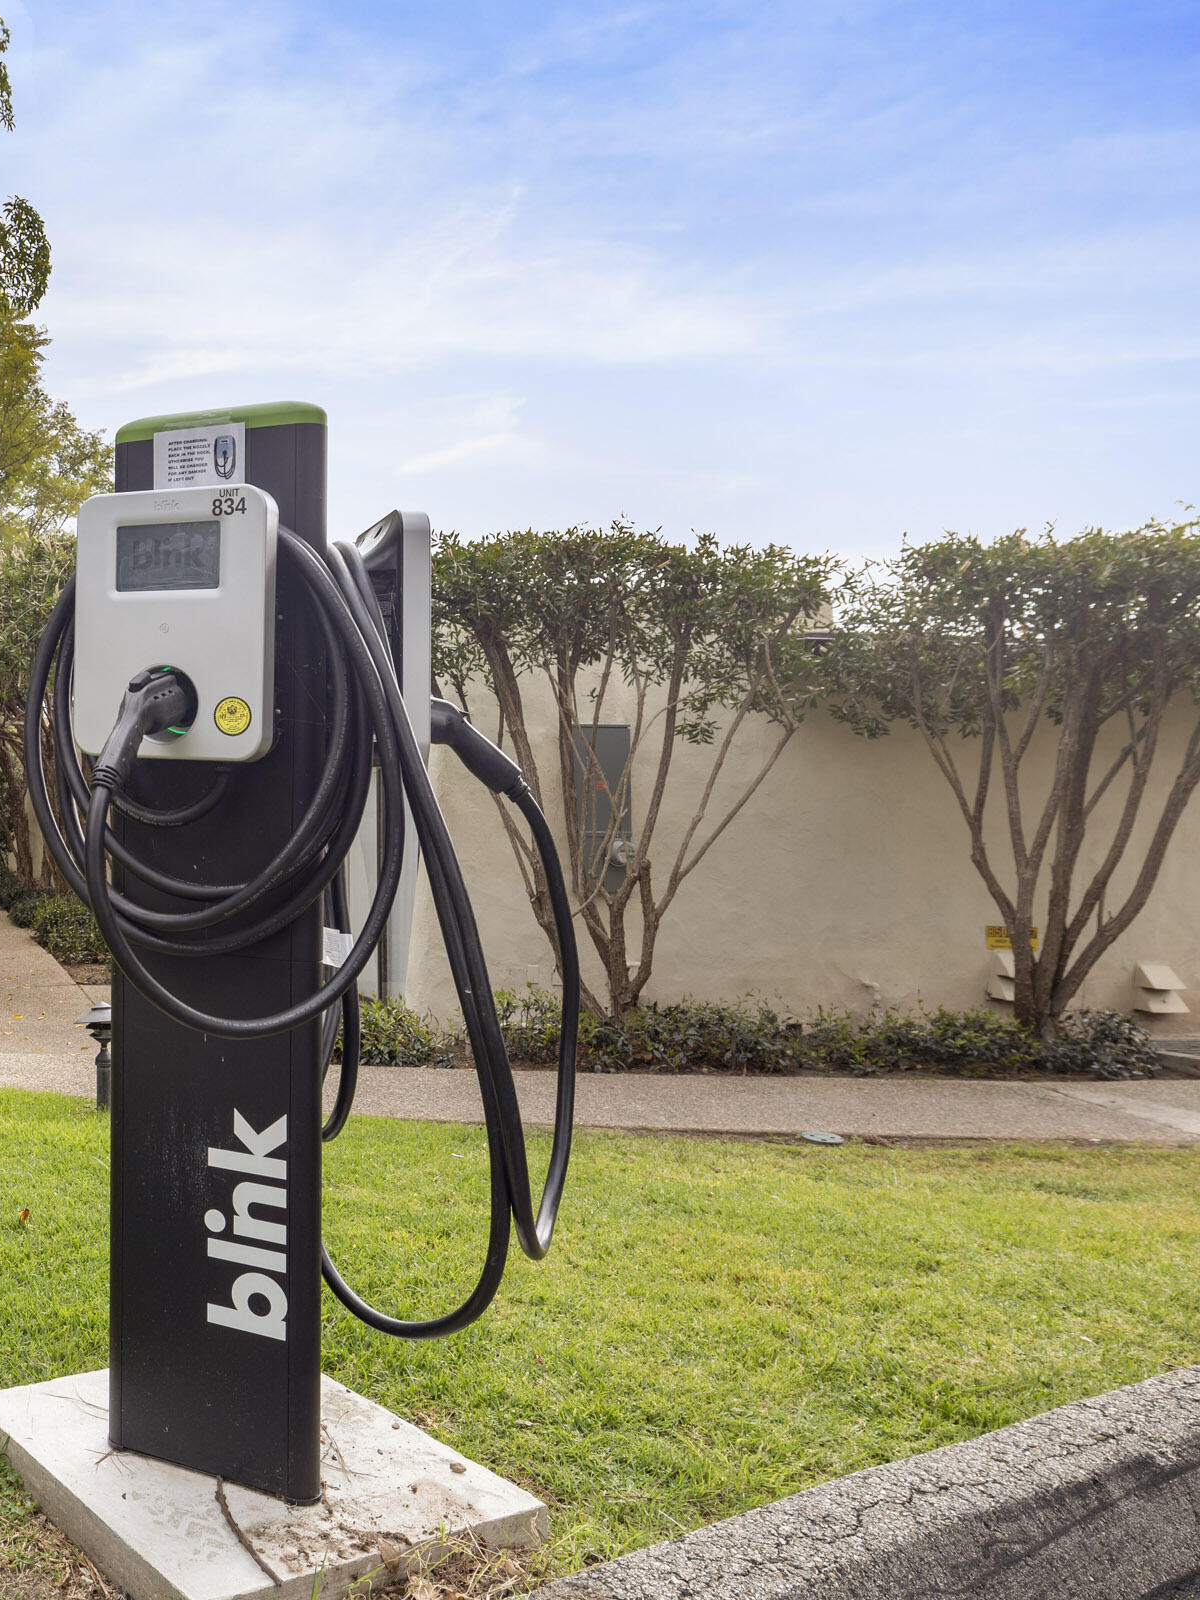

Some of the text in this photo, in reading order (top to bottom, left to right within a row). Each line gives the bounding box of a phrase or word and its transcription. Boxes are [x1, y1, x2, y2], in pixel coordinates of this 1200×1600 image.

[219, 488, 240, 498] UNIT
[212, 497, 247, 516] 834
[132, 537, 206, 570] blink
[204, 1107, 289, 1342] blink
